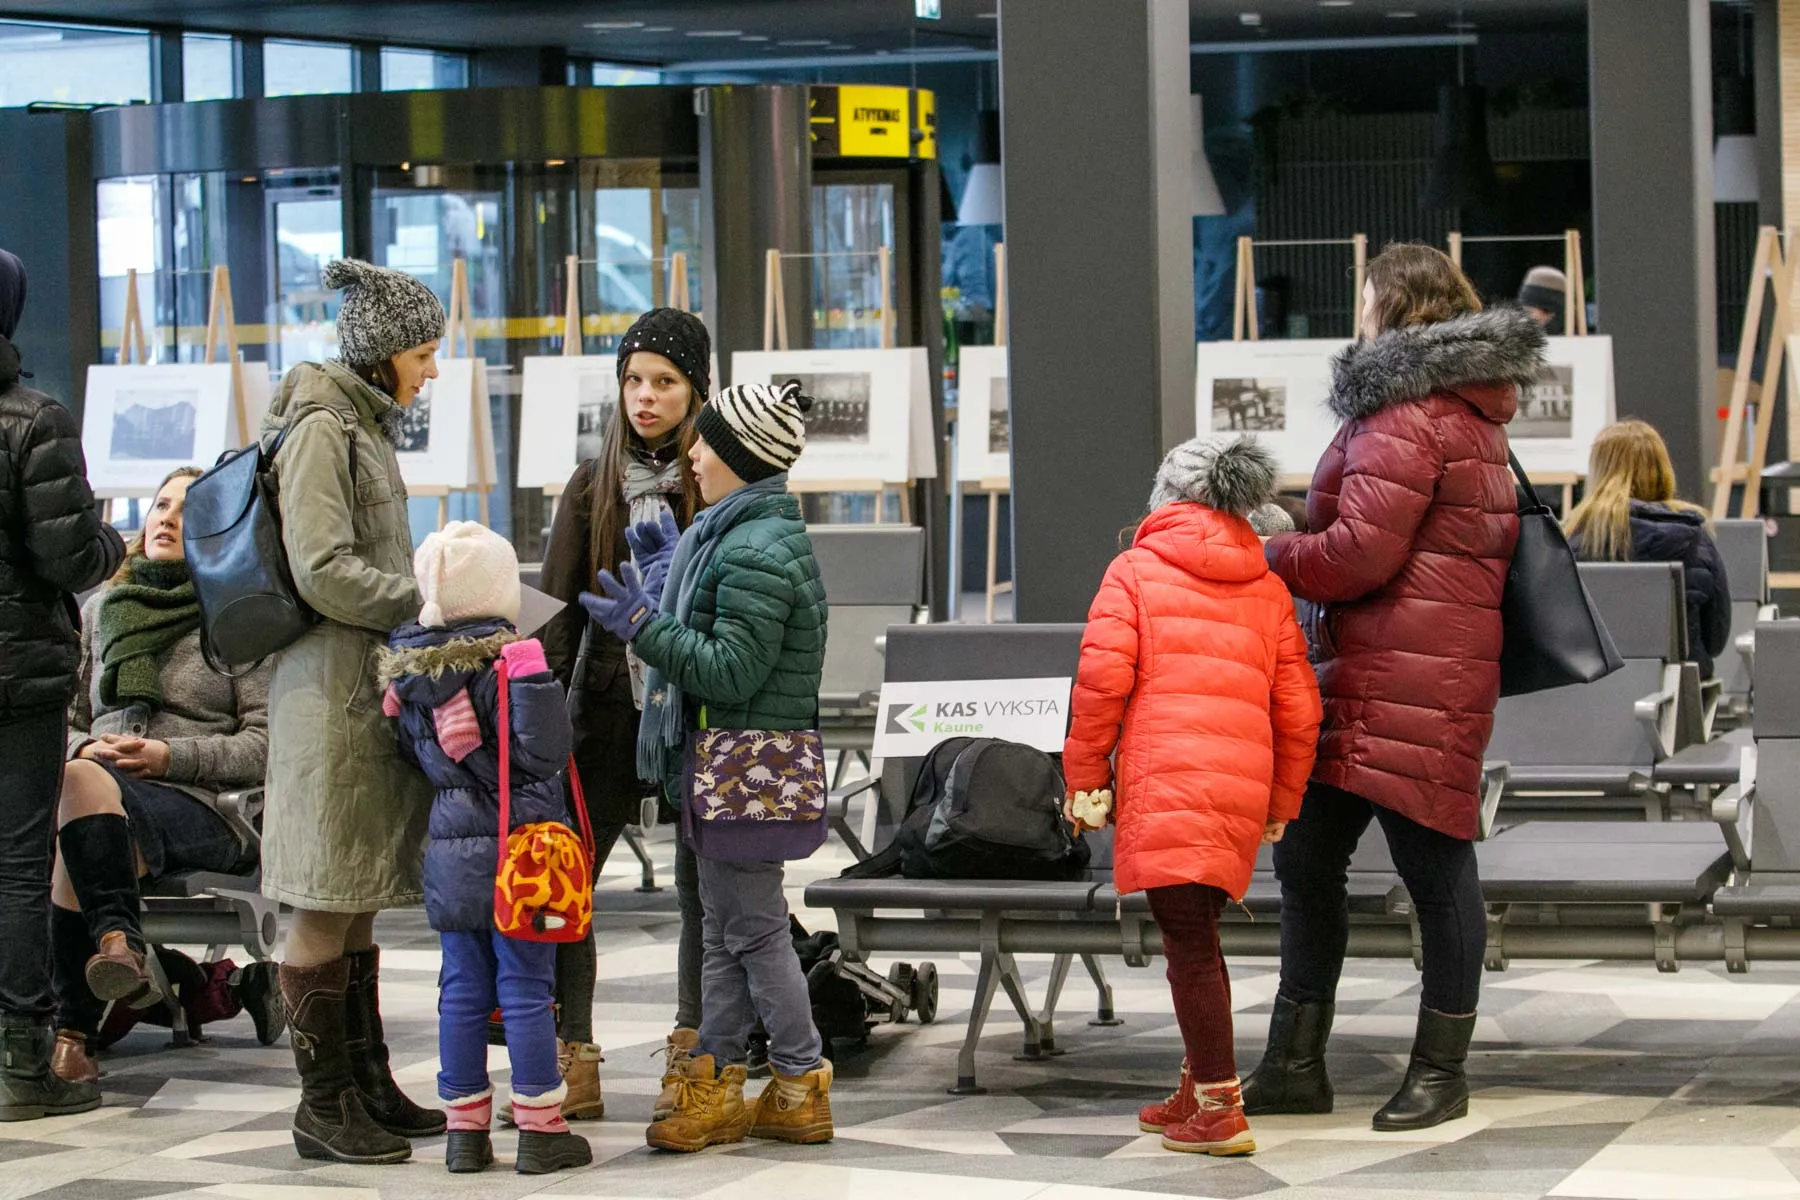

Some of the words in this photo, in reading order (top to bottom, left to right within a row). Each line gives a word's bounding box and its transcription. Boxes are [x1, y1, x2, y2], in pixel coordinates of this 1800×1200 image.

[935, 702, 978, 718] KAS
[984, 699, 1059, 716] VYKSTA
[933, 721, 984, 734] Kaune
